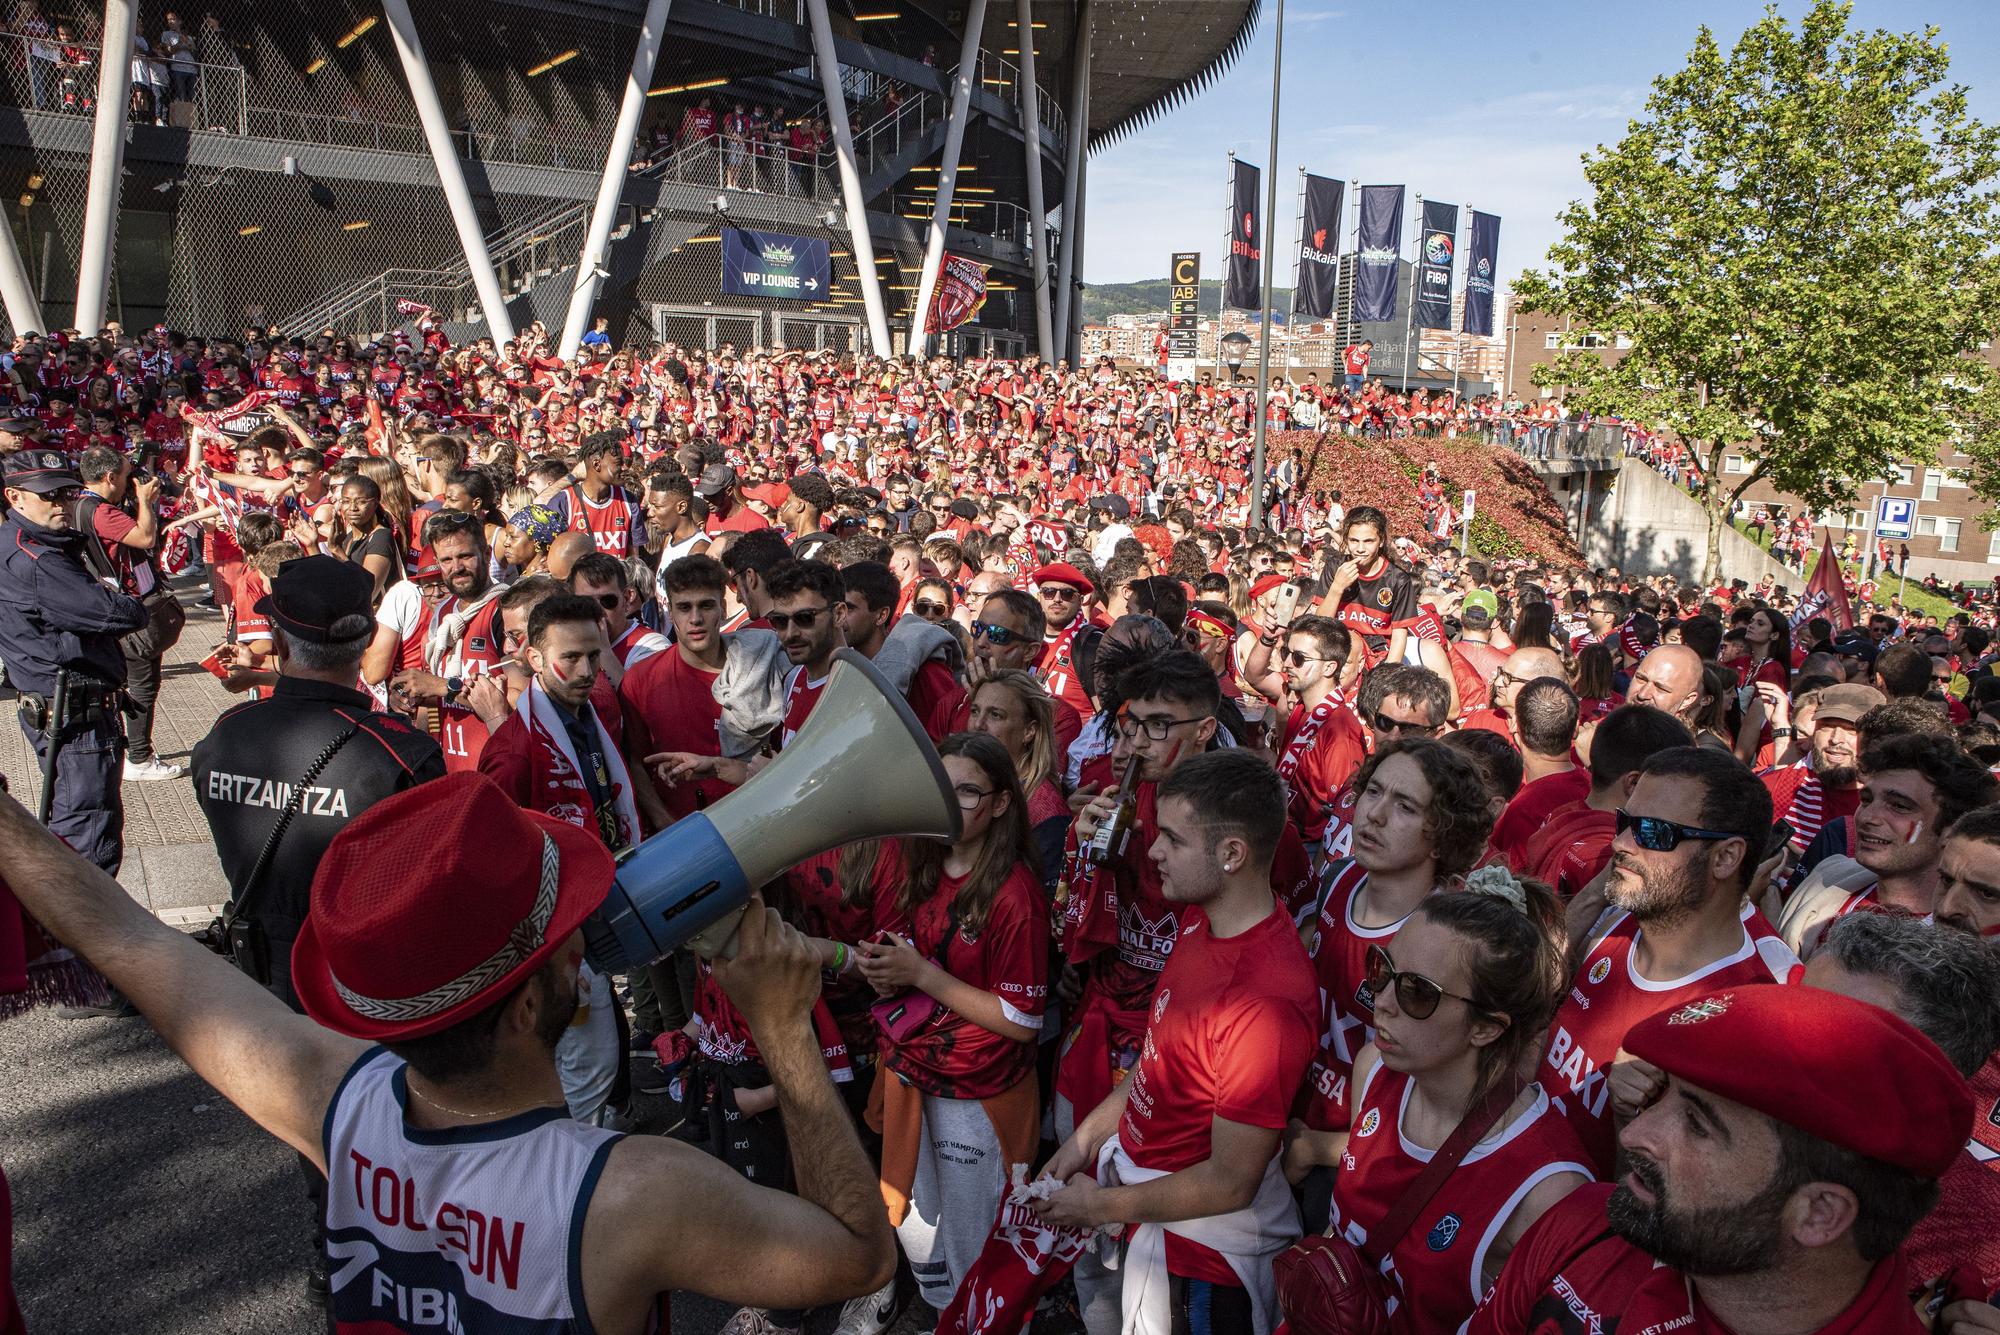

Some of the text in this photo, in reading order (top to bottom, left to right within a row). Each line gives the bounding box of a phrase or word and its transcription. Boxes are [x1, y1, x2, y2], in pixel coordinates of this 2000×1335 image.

[762, 252, 795, 263] FINAL FOUR
[1302, 246, 1337, 265] Bizkaia
[743, 271, 800, 289] VIP LOUNGE
[1175, 260, 1195, 284] C
[1426, 270, 1448, 286] FIBA
[1371, 340, 1416, 354] eihatia
[1885, 501, 1908, 522] P
[594, 530, 627, 550] AXI
[445, 722, 468, 757] 11
[208, 770, 349, 818] ERTZAINTZA
[1549, 1025, 1610, 1119] BAXI
[951, 1141, 986, 1158] HAMPTON
[956, 1156, 979, 1166] ISLAND
[350, 1148, 525, 1292] TOLSON
